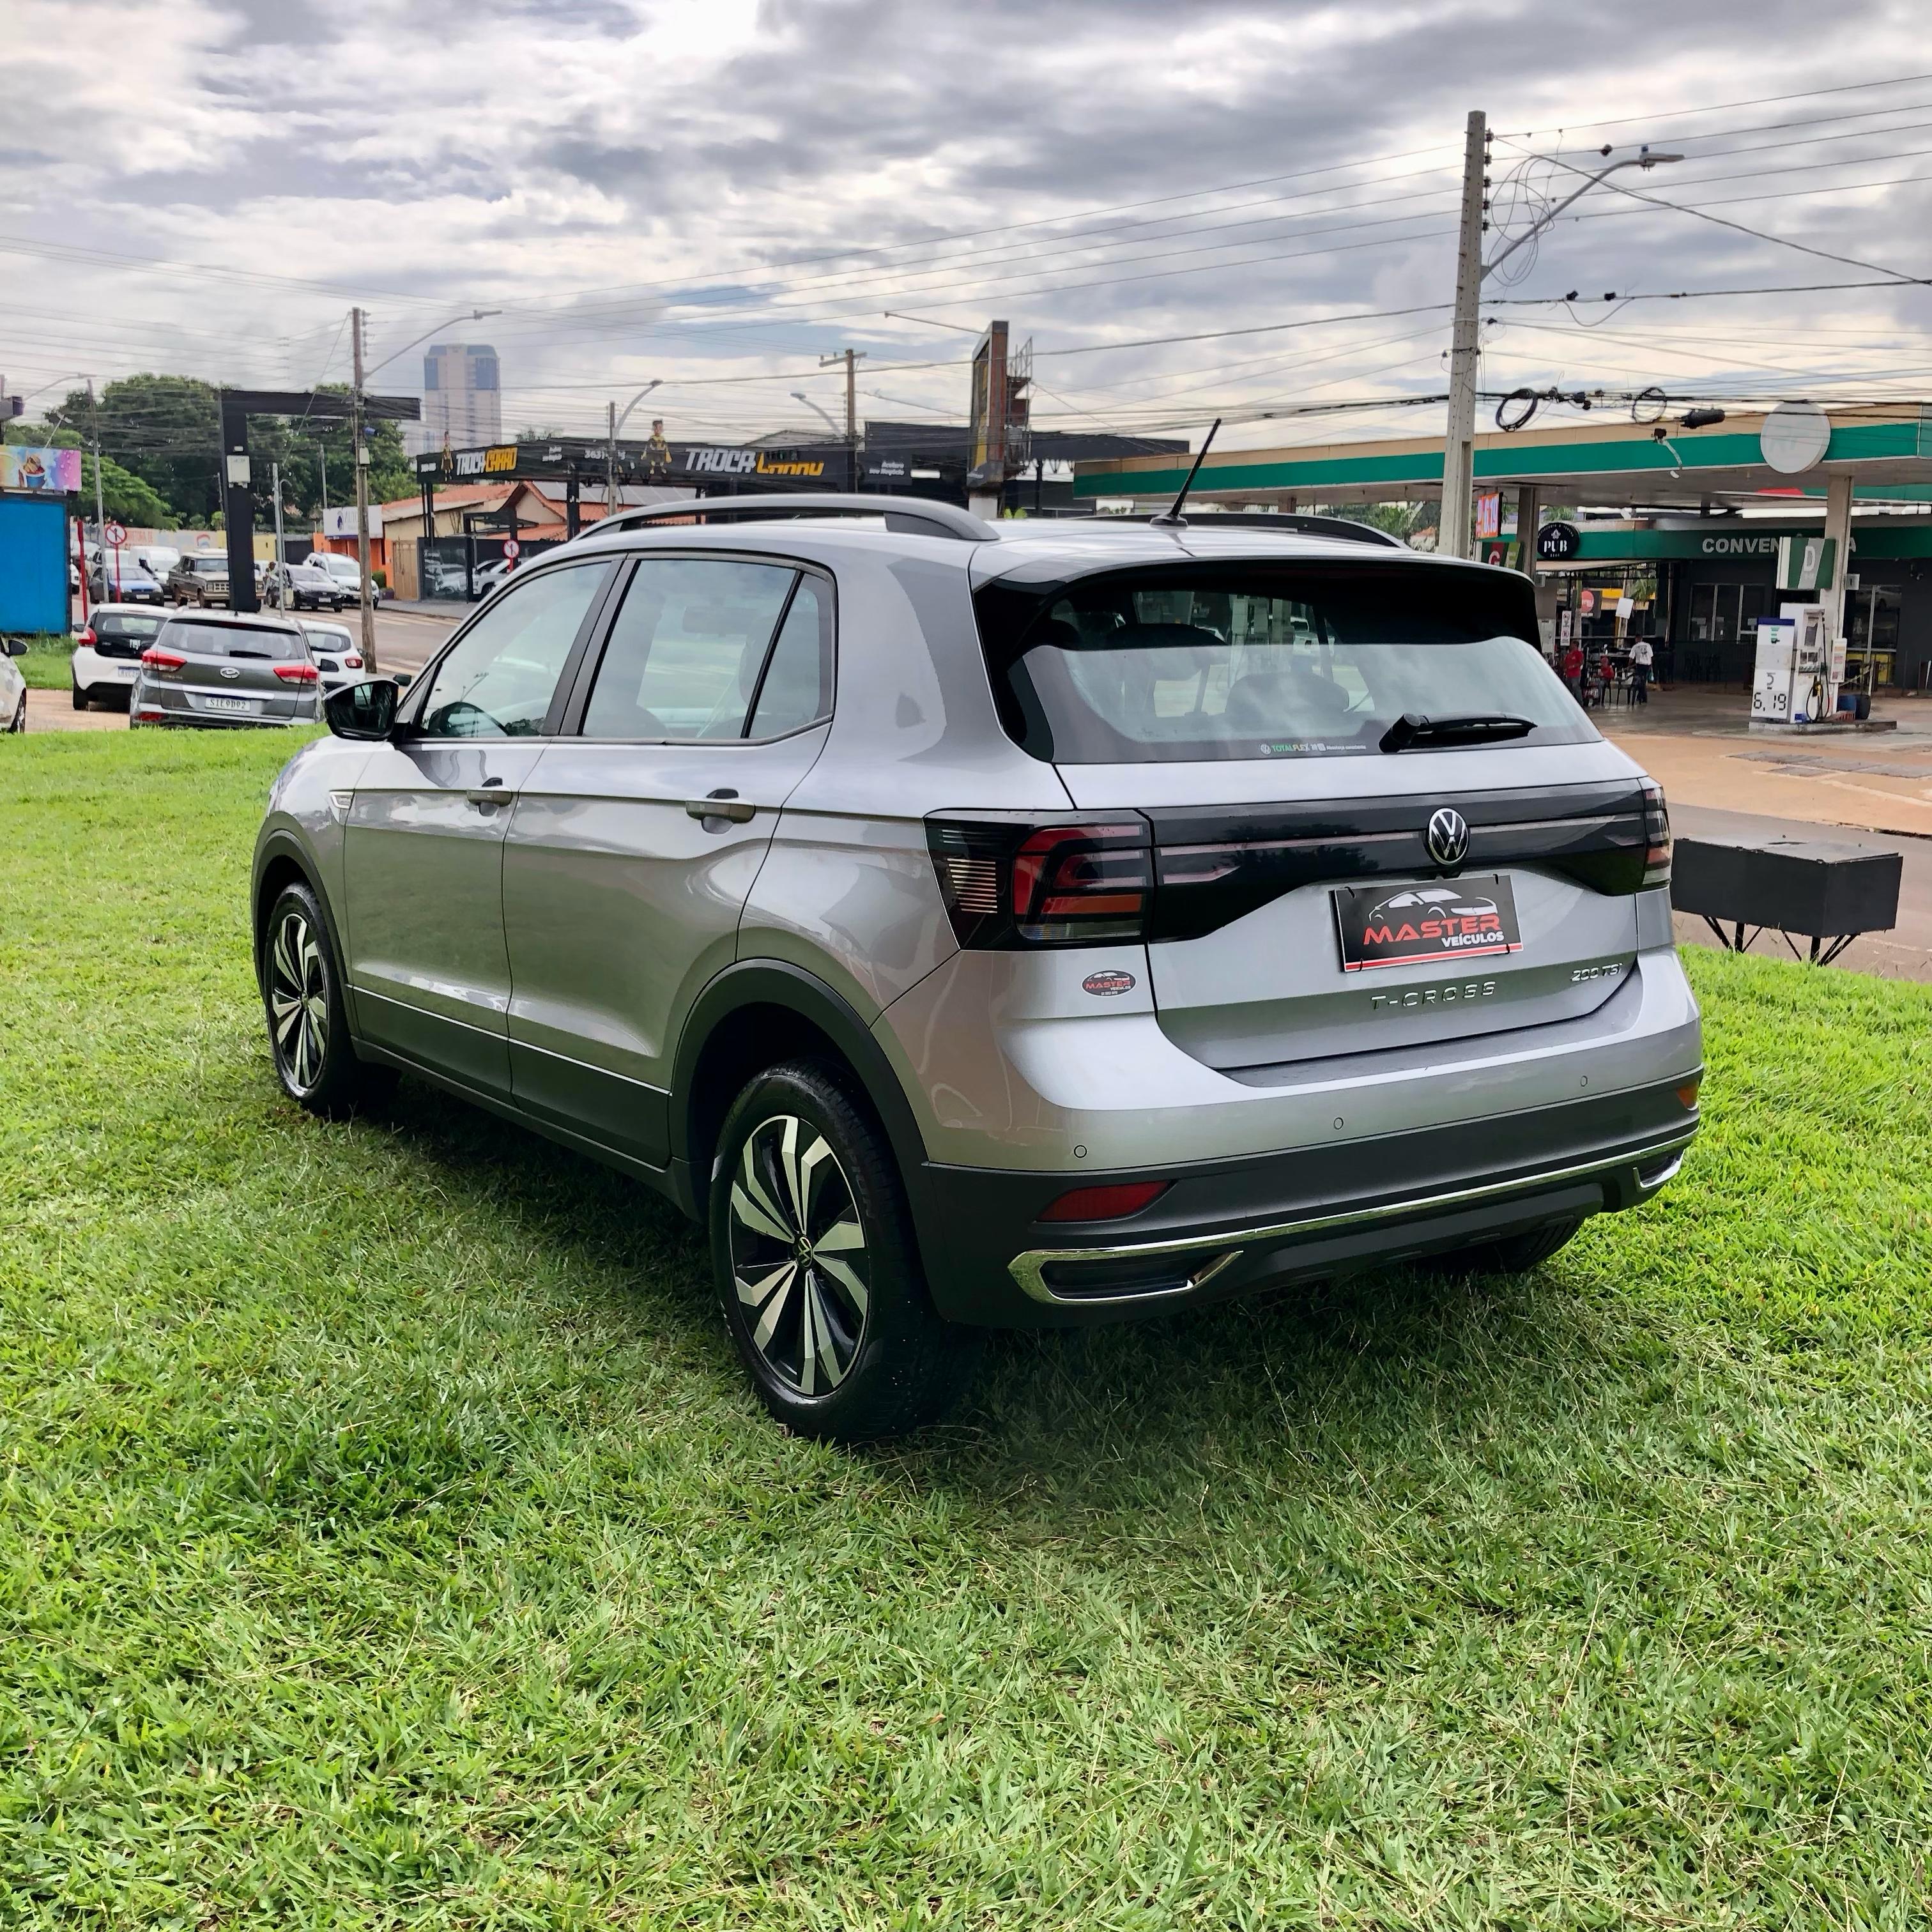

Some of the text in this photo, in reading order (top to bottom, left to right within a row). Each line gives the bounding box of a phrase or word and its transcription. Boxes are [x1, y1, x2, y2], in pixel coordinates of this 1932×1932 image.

[456, 451, 486, 475] TROCA
[685, 448, 756, 473] TROCA
[1544, 540, 1567, 553] PUB
[1804, 546, 1816, 572] D
[1363, 913, 1501, 945] MASTER
[1441, 931, 1505, 947] VEÍCULOS
[1085, 980, 1130, 989] MASTER
[1370, 981, 1496, 1010] T-CROSS
